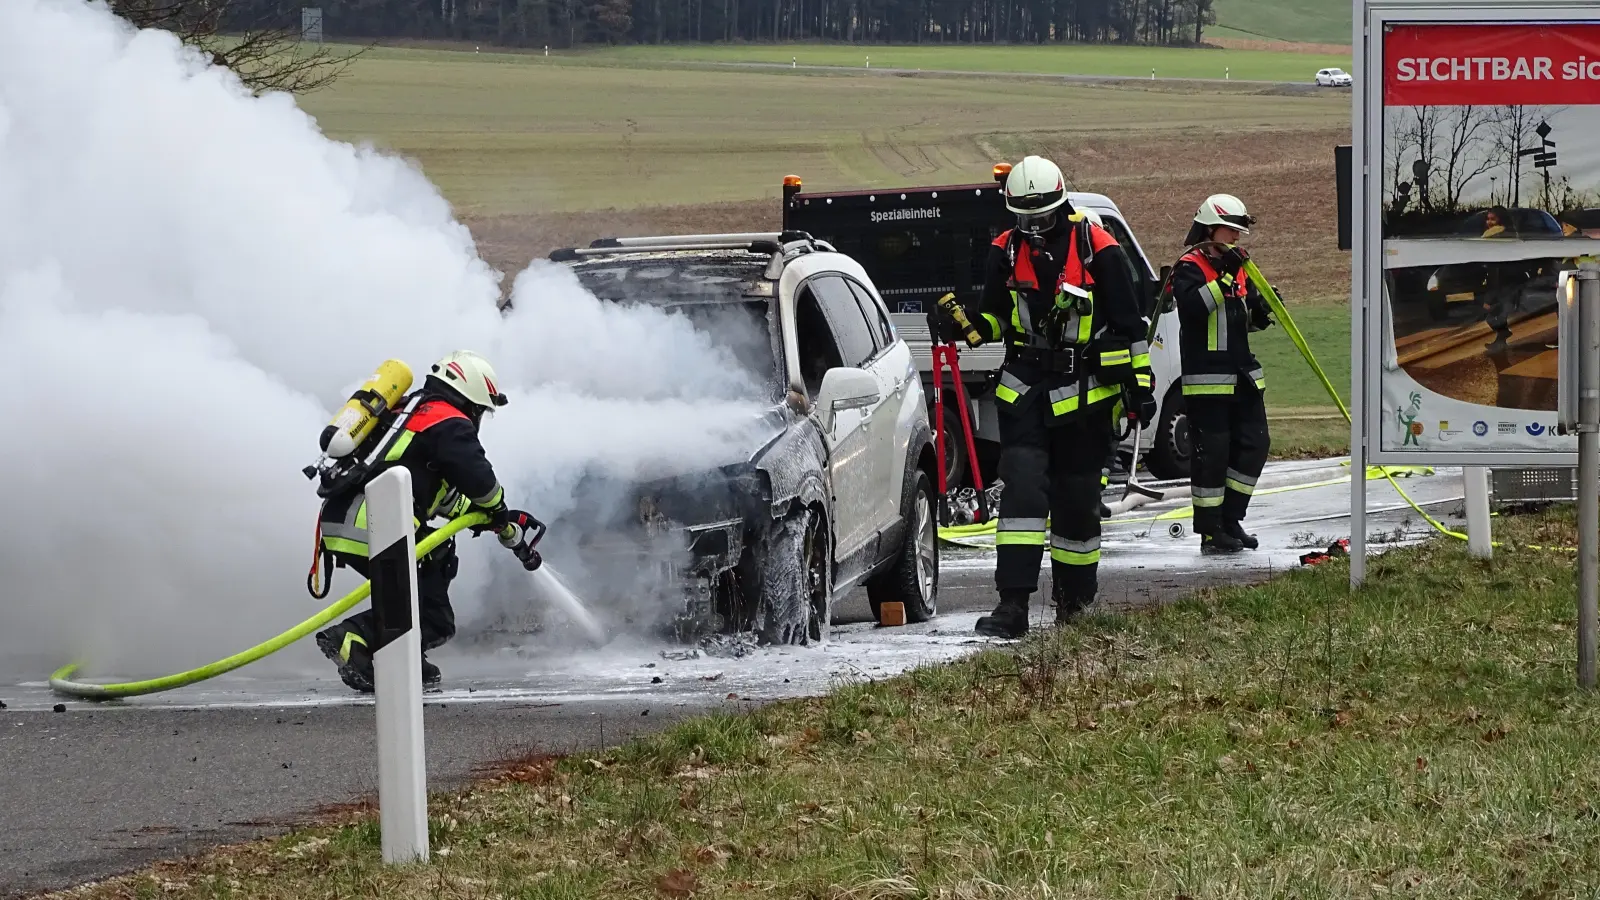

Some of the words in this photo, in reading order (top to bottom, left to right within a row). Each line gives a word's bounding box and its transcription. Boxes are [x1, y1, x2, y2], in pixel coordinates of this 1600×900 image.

[1397, 57, 1554, 81] SICHTBAR
[1562, 55, 1600, 80] sic
[1028, 180, 1035, 190] A
[870, 206, 941, 223] Spezialeinheit
